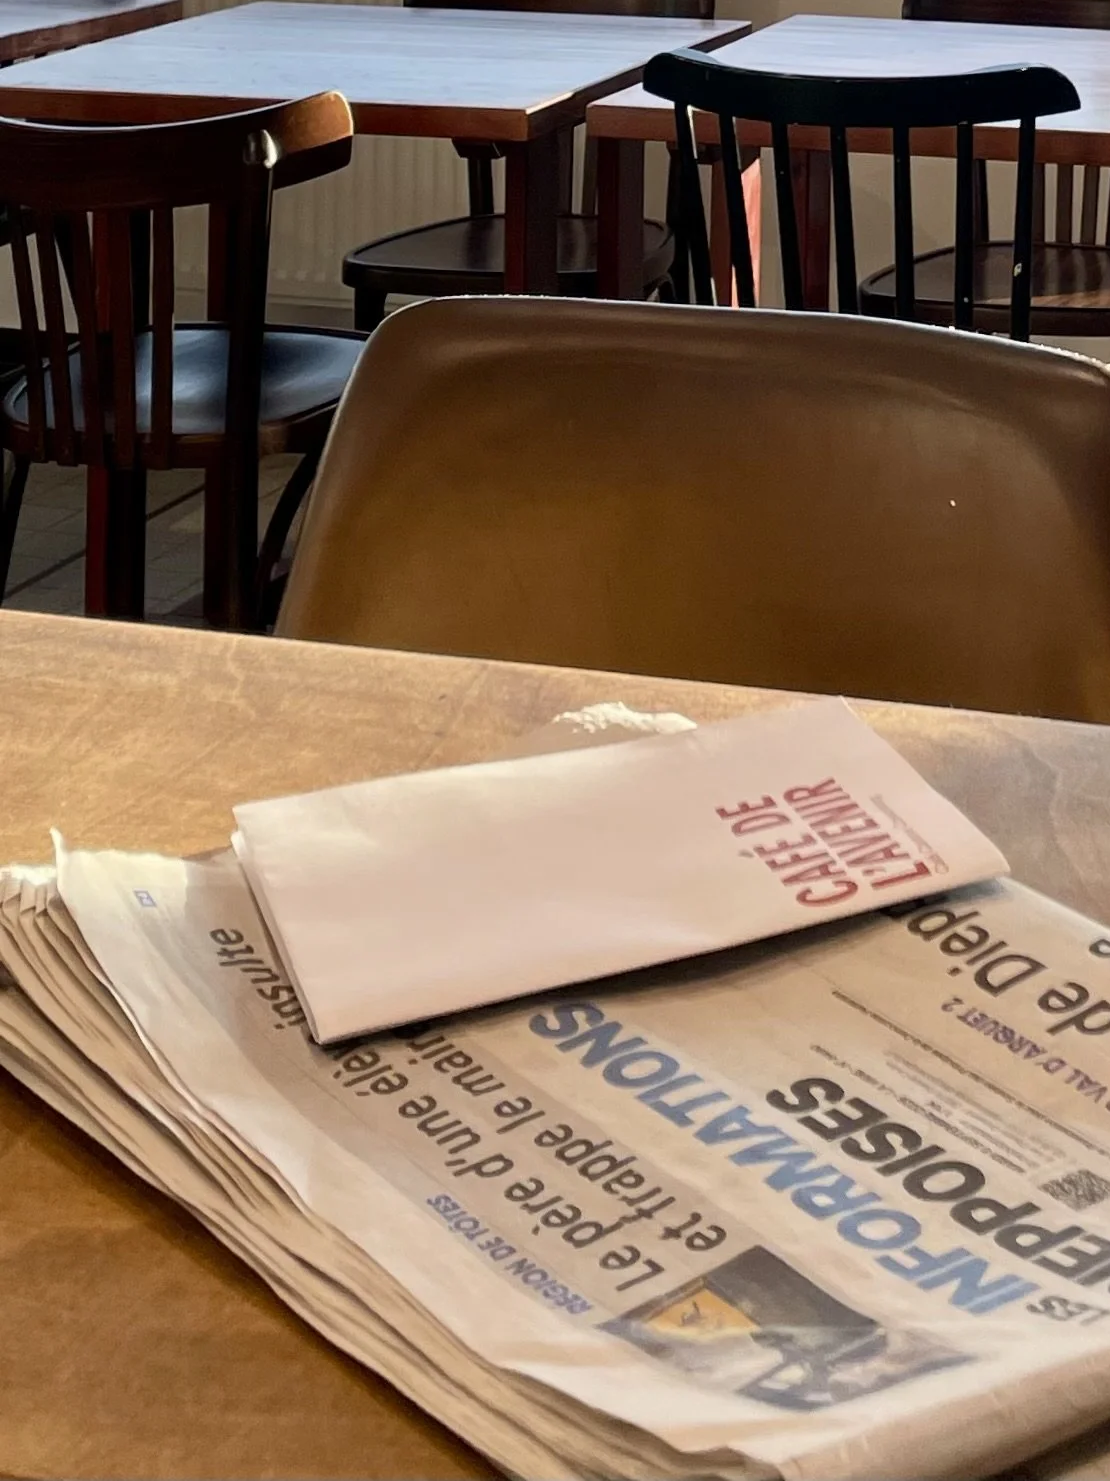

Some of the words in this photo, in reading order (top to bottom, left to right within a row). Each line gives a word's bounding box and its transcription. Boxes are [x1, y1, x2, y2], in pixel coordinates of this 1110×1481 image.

[715, 794, 792, 838] DE
[783, 776, 932, 891] L'AVENIR
[737, 831, 859, 908] CAFÉ
[209, 927, 307, 1030] insulte
[940, 997, 965, 1013] 2
[401, 1034, 506, 1096] mair
[1064, 1067, 1108, 1104] VAL
[399, 1094, 515, 1177] d'une
[494, 1095, 546, 1135] le
[529, 1001, 1042, 1316] INFORMATIONS
[533, 1123, 676, 1224] frappe
[503, 1176, 623, 1249] père
[659, 1211, 727, 1252] et
[477, 1234, 517, 1262] DE
[598, 1245, 666, 1292] Le
